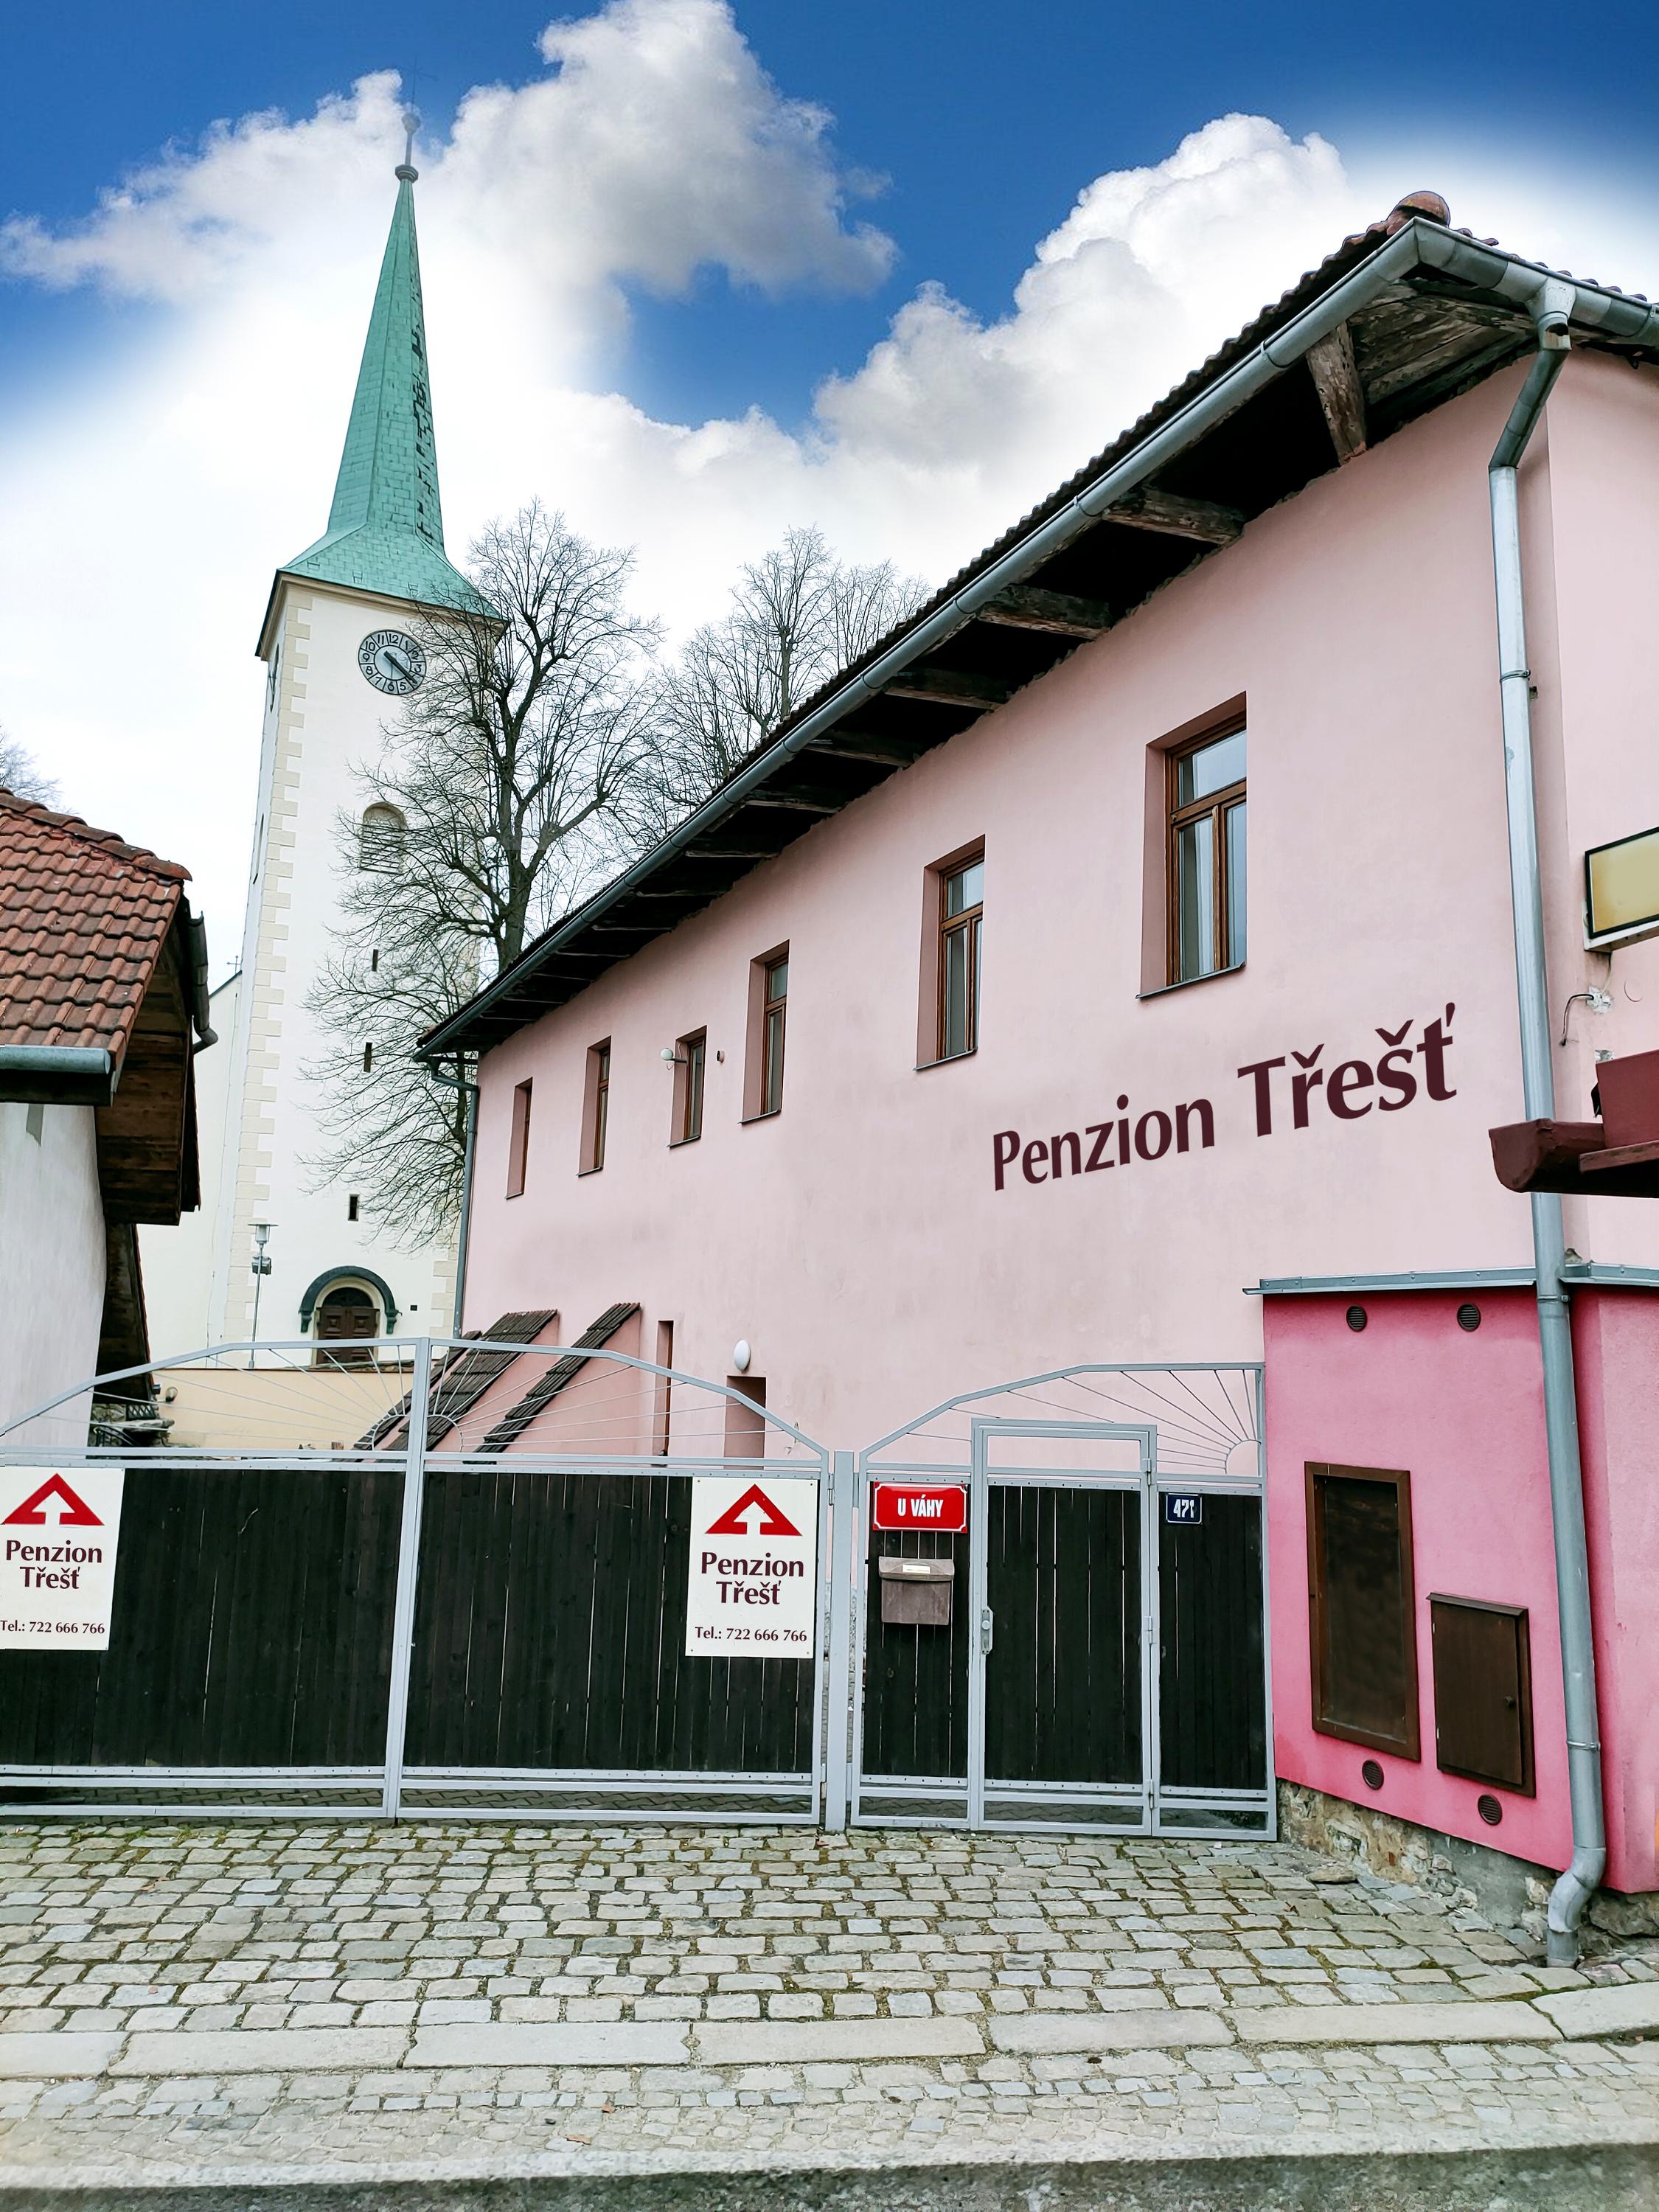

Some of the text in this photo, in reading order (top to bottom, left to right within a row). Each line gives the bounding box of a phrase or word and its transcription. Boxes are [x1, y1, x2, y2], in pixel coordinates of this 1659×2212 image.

[378, 635, 384, 644] 11
[389, 633, 399, 644] 12
[365, 641, 375, 651] 10
[363, 653, 370, 661] 9
[366, 666, 372, 675] 8
[414, 664, 421, 672] 3
[375, 676, 383, 685] 7
[388, 681, 394, 691] 6
[400, 682, 406, 690] 5
[993, 1002, 1458, 1192] Penzion Třešť
[897, 1494, 944, 1517] U VÁHY
[1173, 1498, 1194, 1519] 471
[6, 1540, 102, 1563] Penzion
[701, 1551, 804, 1577] Penzion
[19, 1566, 80, 1590] Třešť
[716, 1580, 782, 1605] Třešť
[0, 1620, 105, 1635] Tel.: 722 666 766
[695, 1627, 807, 1642] Tel.: 722 666 766
